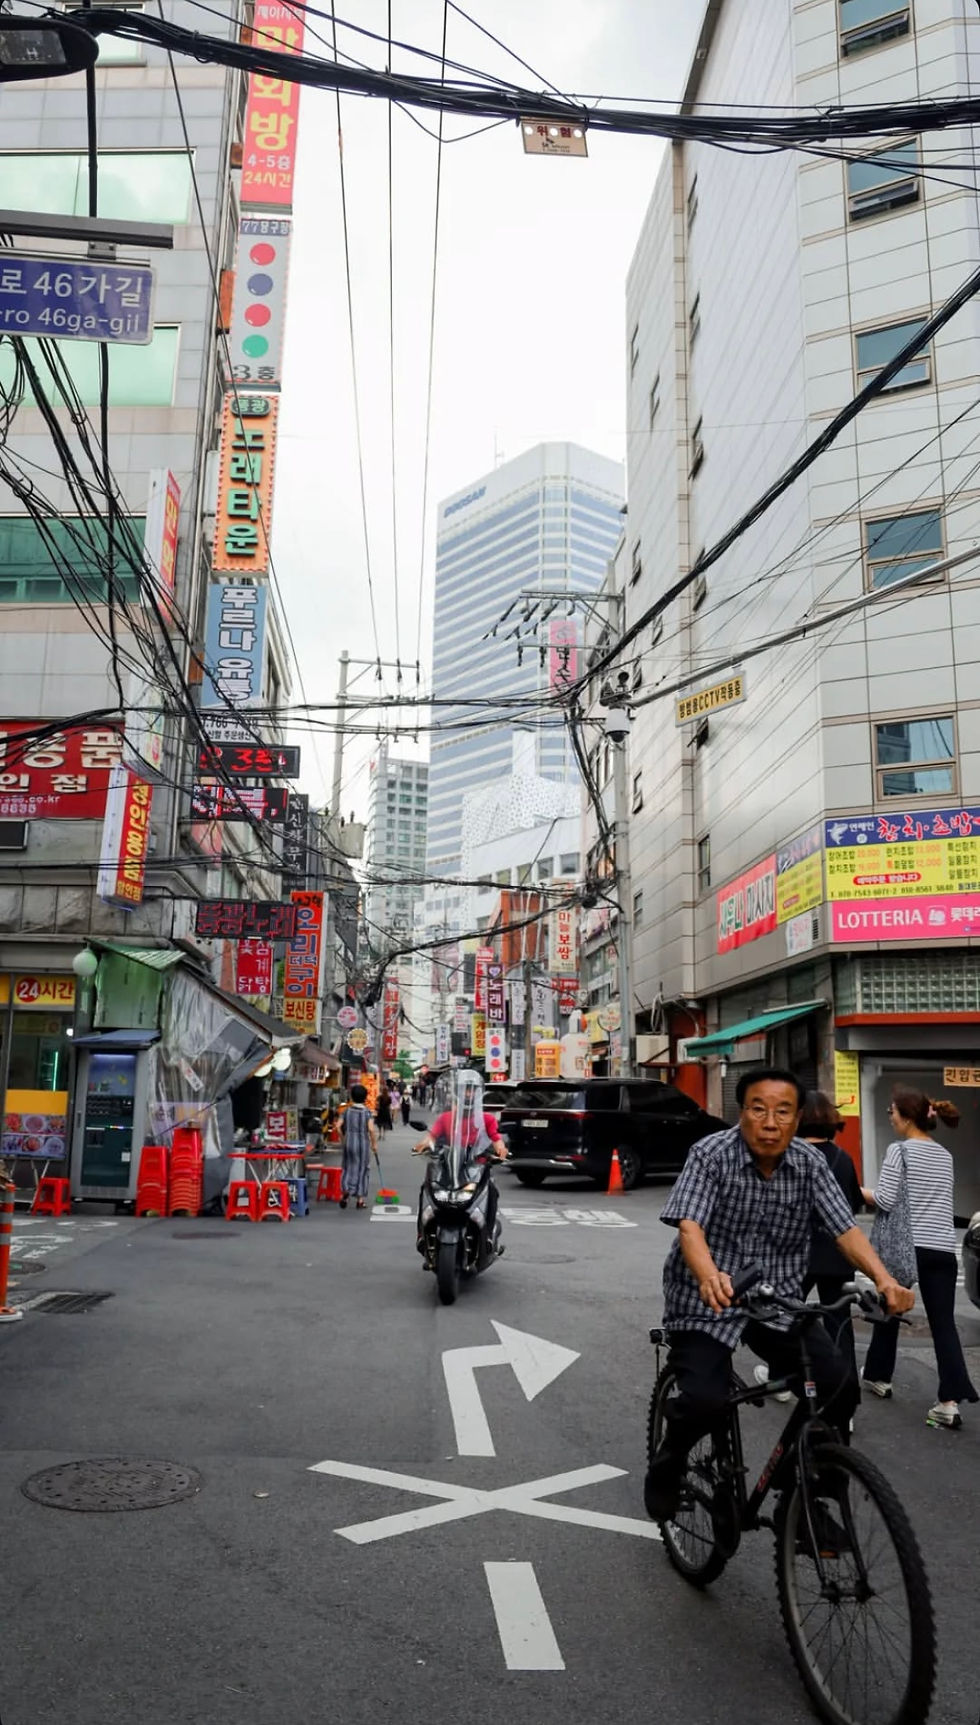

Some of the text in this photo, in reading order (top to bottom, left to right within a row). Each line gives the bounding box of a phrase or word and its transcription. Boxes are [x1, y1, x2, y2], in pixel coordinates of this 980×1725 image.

[244, 171, 292, 188] 24시간
[0, 268, 27, 295] 로
[37, 307, 140, 334] 46ga-gil
[225, 417, 265, 556] 노래타운
[838, 909, 923, 929] LOTTERIA
[557, 910, 572, 960] 마늘보쌈
[18, 981, 74, 999] 24시간
[285, 1000, 316, 1020] 보신탕
